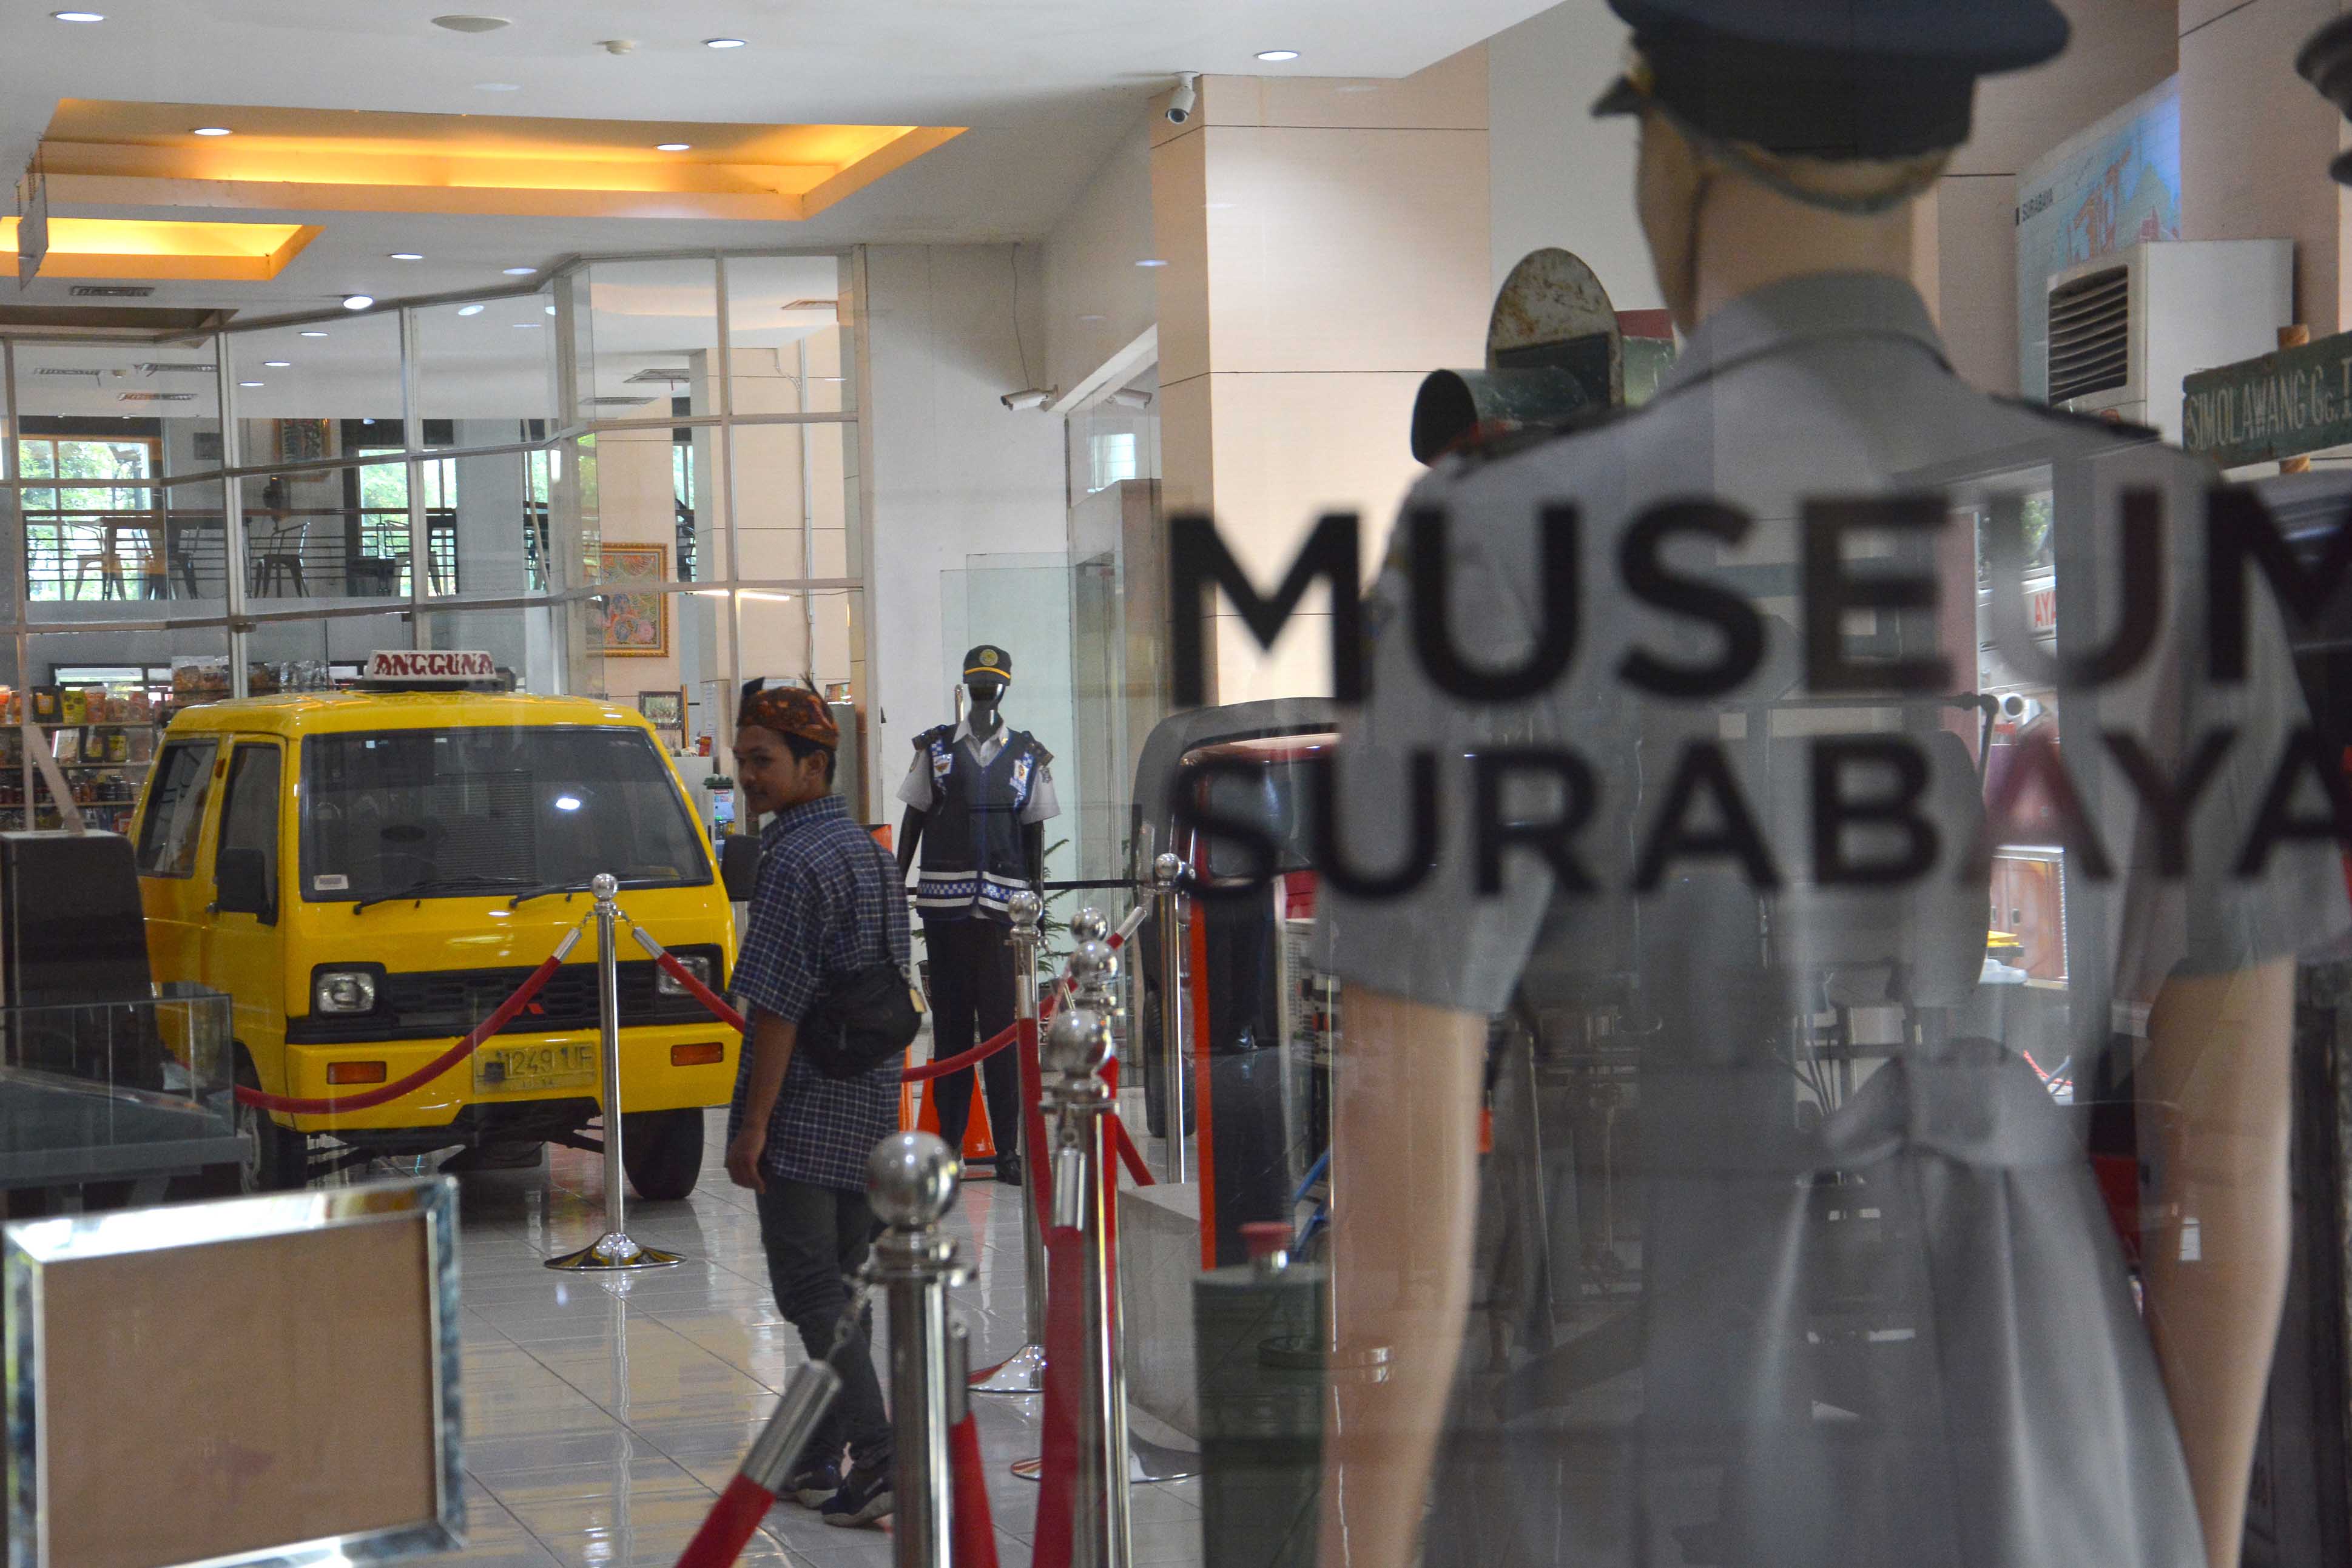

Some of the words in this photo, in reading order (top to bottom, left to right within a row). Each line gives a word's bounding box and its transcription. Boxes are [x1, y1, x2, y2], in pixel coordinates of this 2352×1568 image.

[374, 653, 494, 676] ANGGUNA
[1168, 488, 2352, 707] MUSEUM
[1171, 728, 2352, 900] SURABAYA
